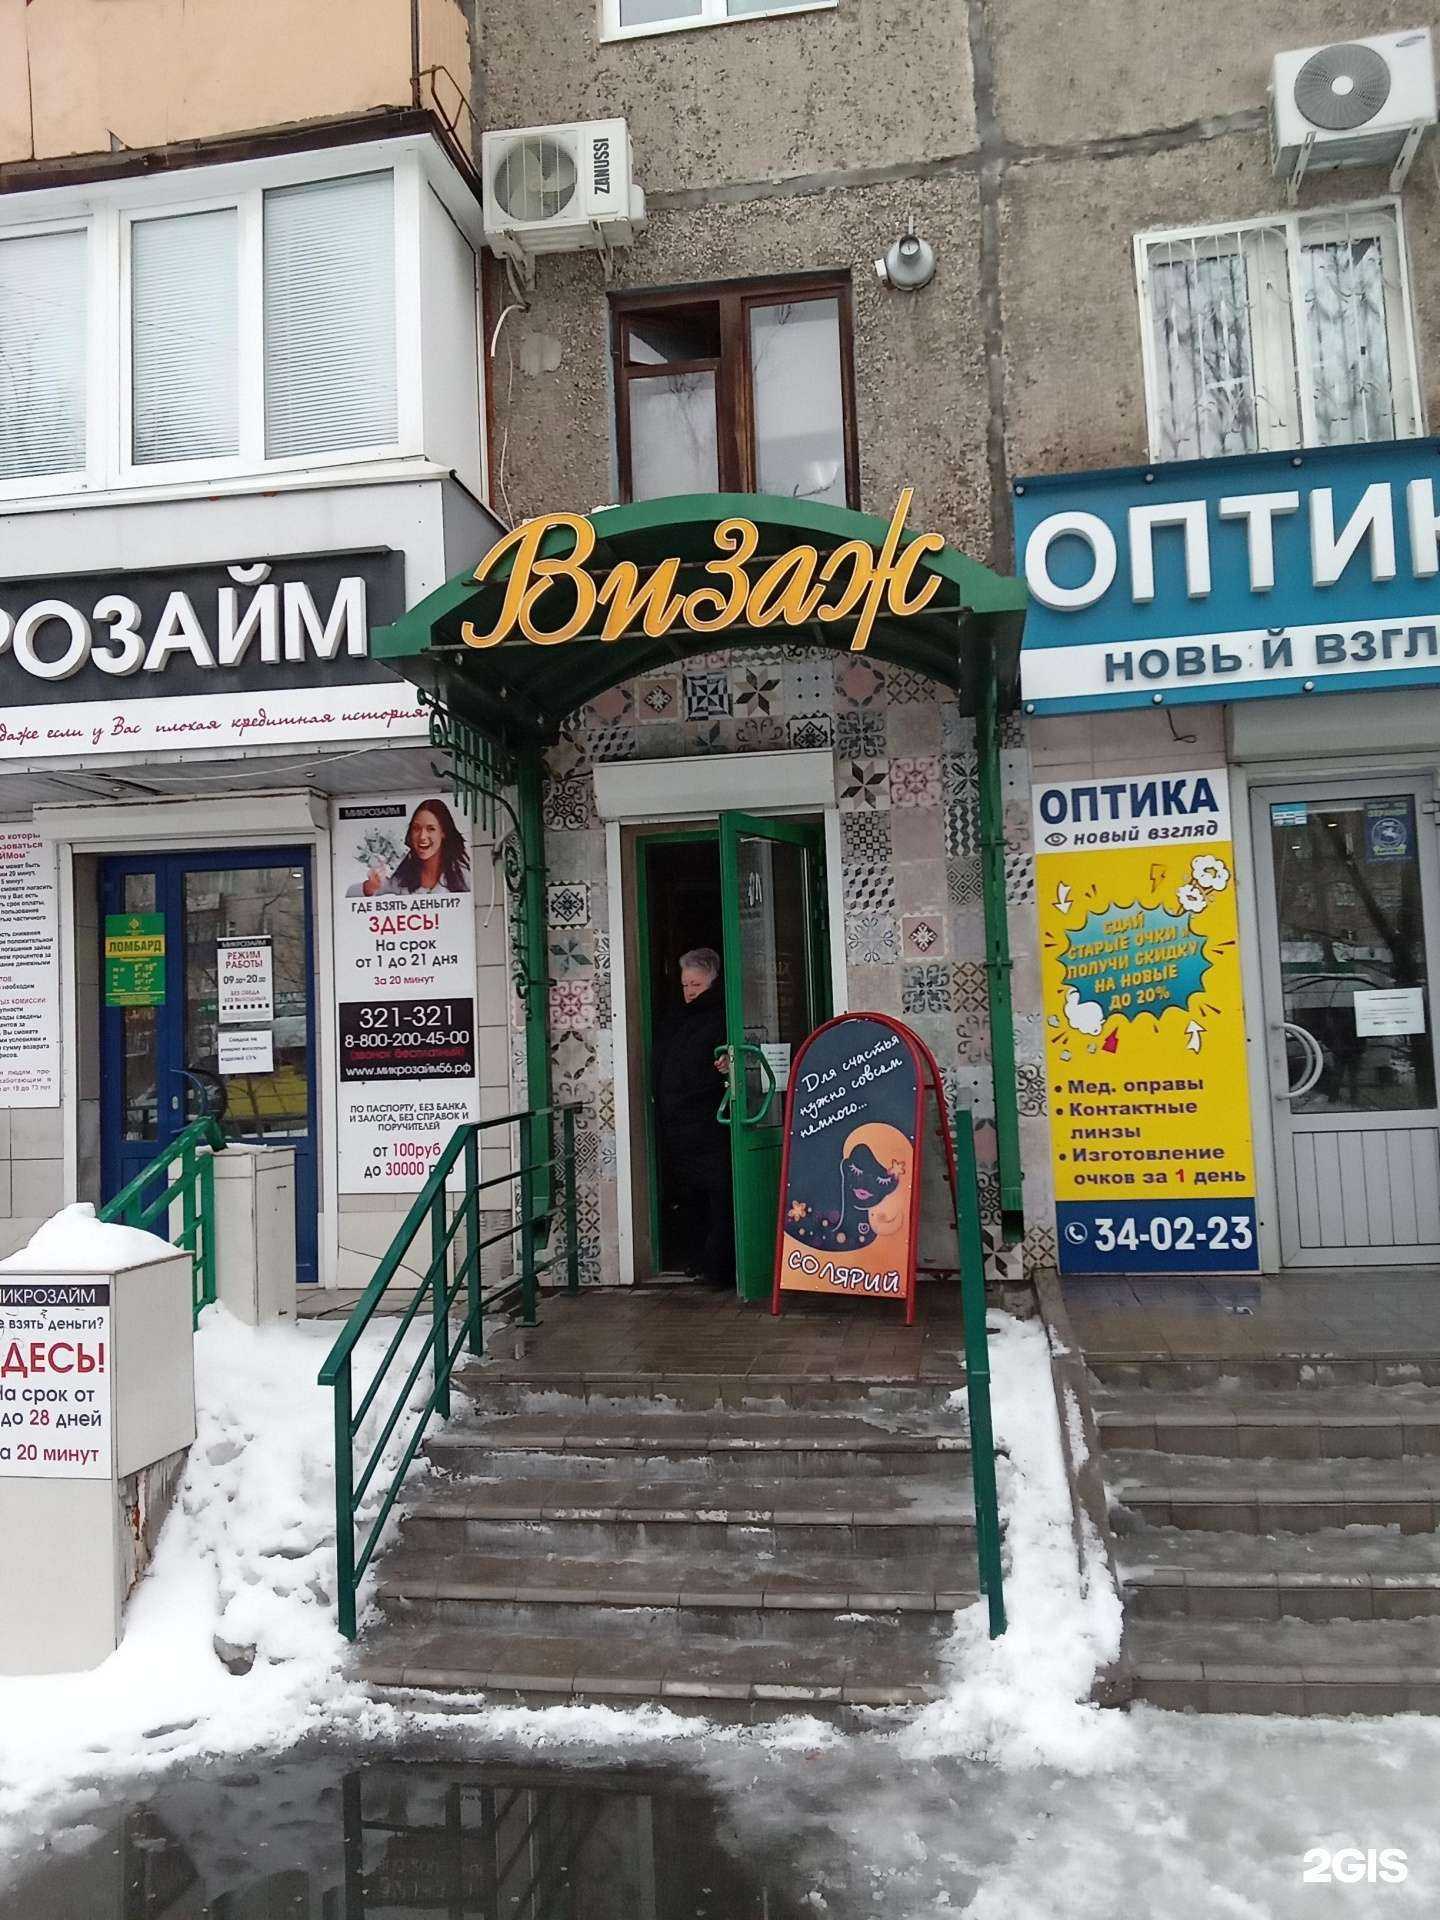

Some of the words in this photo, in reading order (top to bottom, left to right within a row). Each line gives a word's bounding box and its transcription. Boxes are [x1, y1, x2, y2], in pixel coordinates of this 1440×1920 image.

[593, 137, 610, 195] ZANUSSI
[461, 487, 945, 651] Визаж
[1315, 625, 1438, 665] ВЗГЛ
[47, 729, 84, 738] если
[92, 727, 104, 745] у
[111, 716, 142, 736] Вас
[155, 718, 220, 733] плохая
[231, 709, 335, 736] кредитная
[1040, 777, 1219, 825] ОПТИКА
[1073, 826, 1139, 845] новый
[1148, 820, 1219, 839] взгляд
[351, 902, 372, 913] ГДЕ
[376, 900, 408, 911] ВЗЯТЬ
[410, 898, 461, 911] ДЕНЬГИ?
[369, 914, 439, 935] ЗДЕСЬ!
[1104, 912, 1145, 935] СДАЙ
[109, 940, 162, 954] ЛОМБАРД
[376, 939, 396, 951] На
[400, 938, 436, 954] срок
[1067, 937, 1129, 960] СТАРЫЕ
[1136, 926, 1176, 945] ОЧКИ
[227, 951, 261, 960] РЕЖИМ
[355, 958, 372, 968] от
[377, 955, 383, 967] 1
[388, 957, 407, 968] до
[411, 953, 426, 966] 21
[432, 955, 458, 967] дня
[1067, 956, 1129, 980] ПОЛУЧИ
[1135, 941, 1198, 965] СКИДКУ
[225, 961, 263, 969] РАБОТЫ
[374, 976, 387, 986] За
[390, 976, 401, 985] 20
[403, 975, 435, 986] минут
[1094, 976, 1115, 994] НА
[1121, 964, 1178, 986] НОВЫЕ
[1109, 994, 1132, 1011] ДО
[1136, 986, 1170, 1004] 20%
[359, 1005, 453, 1029] 321-321
[344, 1030, 470, 1048] 8-800-200-45-00
[801, 1068, 837, 1094] Для
[842, 1035, 900, 1072] счастья
[800, 1084, 846, 1119] нужно
[851, 1058, 903, 1088] совсем
[1067, 1080, 1116, 1095] Мед.
[1124, 1078, 1204, 1094] оправы
[350, 1105, 364, 1113] ПО
[366, 1104, 415, 1113] ПАСПОРТУ,
[419, 1103, 434, 1112] БЕЗ
[436, 1102, 468, 1111] БАНКА
[1070, 1101, 1198, 1117] Контактные
[350, 1115, 356, 1123] И
[358, 1114, 396, 1123] ЗАЛОГА,
[399, 1113, 414, 1122] БЕЗ
[416, 1112, 460, 1121] СПРАВОК
[463, 1112, 469, 1120] И
[378, 1121, 441, 1131] ПОРУЧИТЕЛЕЙ
[800, 1101, 868, 1138] немного...
[1070, 1126, 1141, 1140] линзы
[373, 1146, 388, 1157] от
[393, 1143, 441, 1159] 100руб
[1072, 1147, 1225, 1163] Изготовление
[364, 1165, 381, 1179] до
[385, 1162, 424, 1176] 30000
[1074, 1171, 1135, 1185] очков
[1143, 1171, 1167, 1184] за
[1176, 1169, 1185, 1183] 1
[1193, 1169, 1246, 1185] день
[1094, 1216, 1253, 1251] 34-02-23
[787, 1250, 900, 1294] СОЛЯРИЙ
[0, 1287, 95, 1304] ИКРОЗАЙМ
[9, 1319, 44, 1329] взять
[48, 1317, 104, 1331] деньги?
[1, 1342, 105, 1378] ДЕСЬ!
[22, 1388, 68, 1405] срок
[75, 1390, 95, 1402] от
[1, 1412, 24, 1427] до
[29, 1409, 50, 1425] 28
[56, 1410, 102, 1428] дней
[17, 1444, 37, 1461] 20
[44, 1448, 99, 1465] минут
